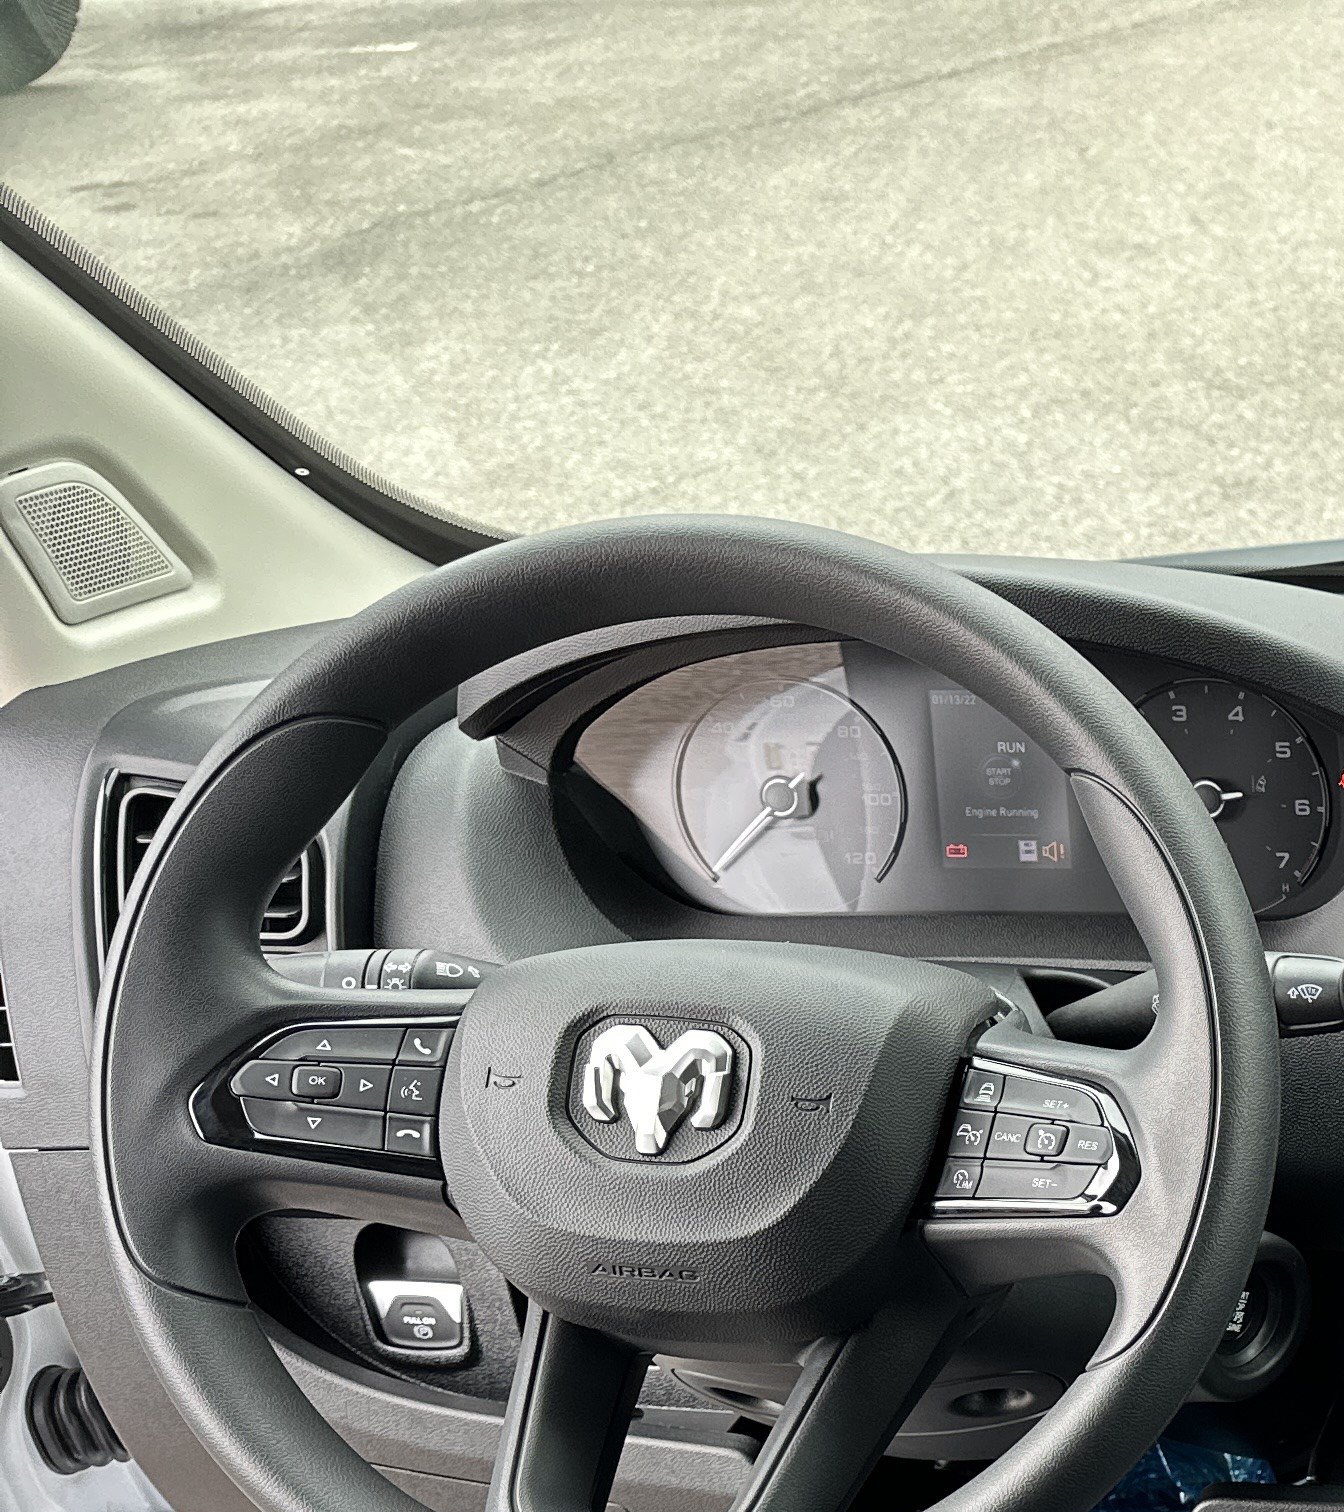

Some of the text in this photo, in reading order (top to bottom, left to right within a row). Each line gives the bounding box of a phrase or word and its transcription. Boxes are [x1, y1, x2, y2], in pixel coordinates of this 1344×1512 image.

[1171, 705, 1187, 721] 3
[1228, 705, 1244, 721] 4
[997, 741, 1026, 753] RUN
[1275, 741, 1291, 758] 5
[986, 767, 1012, 776] START
[988, 777, 1011, 786] STOP
[965, 806, 1039, 819] Engine Running
[1294, 799, 1311, 816] 6
[1276, 852, 1290, 869] 7
[1282, 883, 1290, 893] H
[308, 1075, 326, 1086] OK
[994, 1131, 1022, 1143] CANC
[1077, 1139, 1099, 1151] RES
[591, 1263, 700, 1282] AIRBAG
